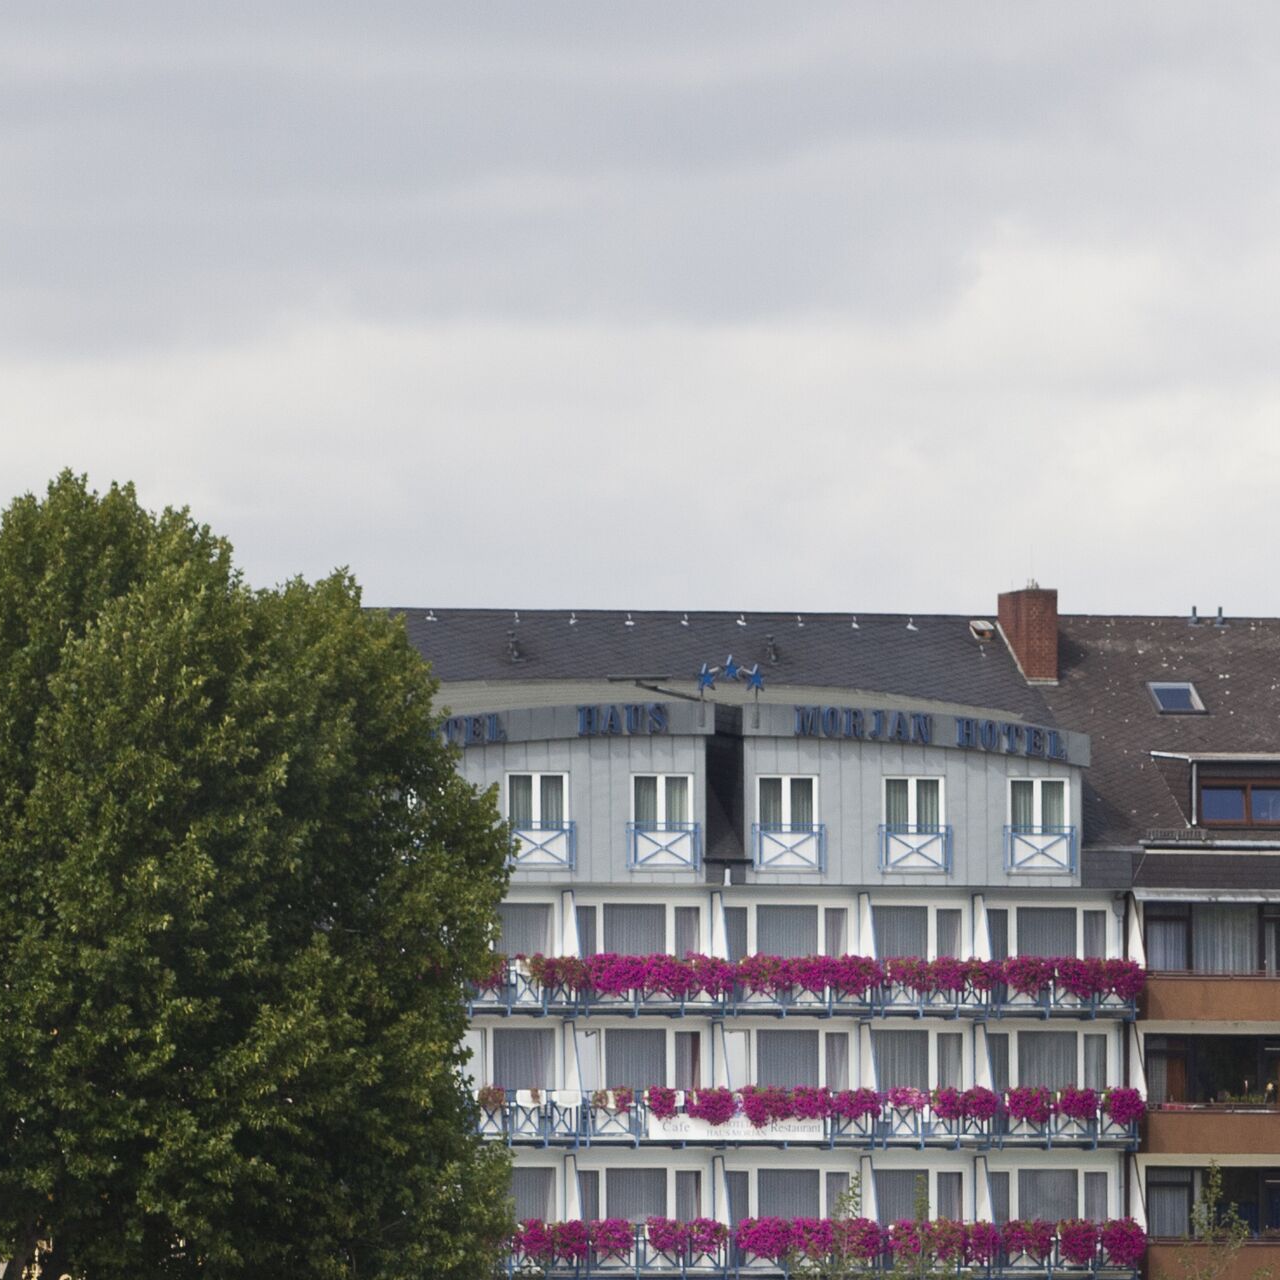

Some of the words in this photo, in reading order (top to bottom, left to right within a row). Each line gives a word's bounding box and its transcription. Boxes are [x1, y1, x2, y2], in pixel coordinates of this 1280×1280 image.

[431, 712, 508, 746] TEL
[576, 703, 669, 737] HAUS
[793, 704, 933, 745] MORJAN
[954, 716, 1066, 760] HOTEL
